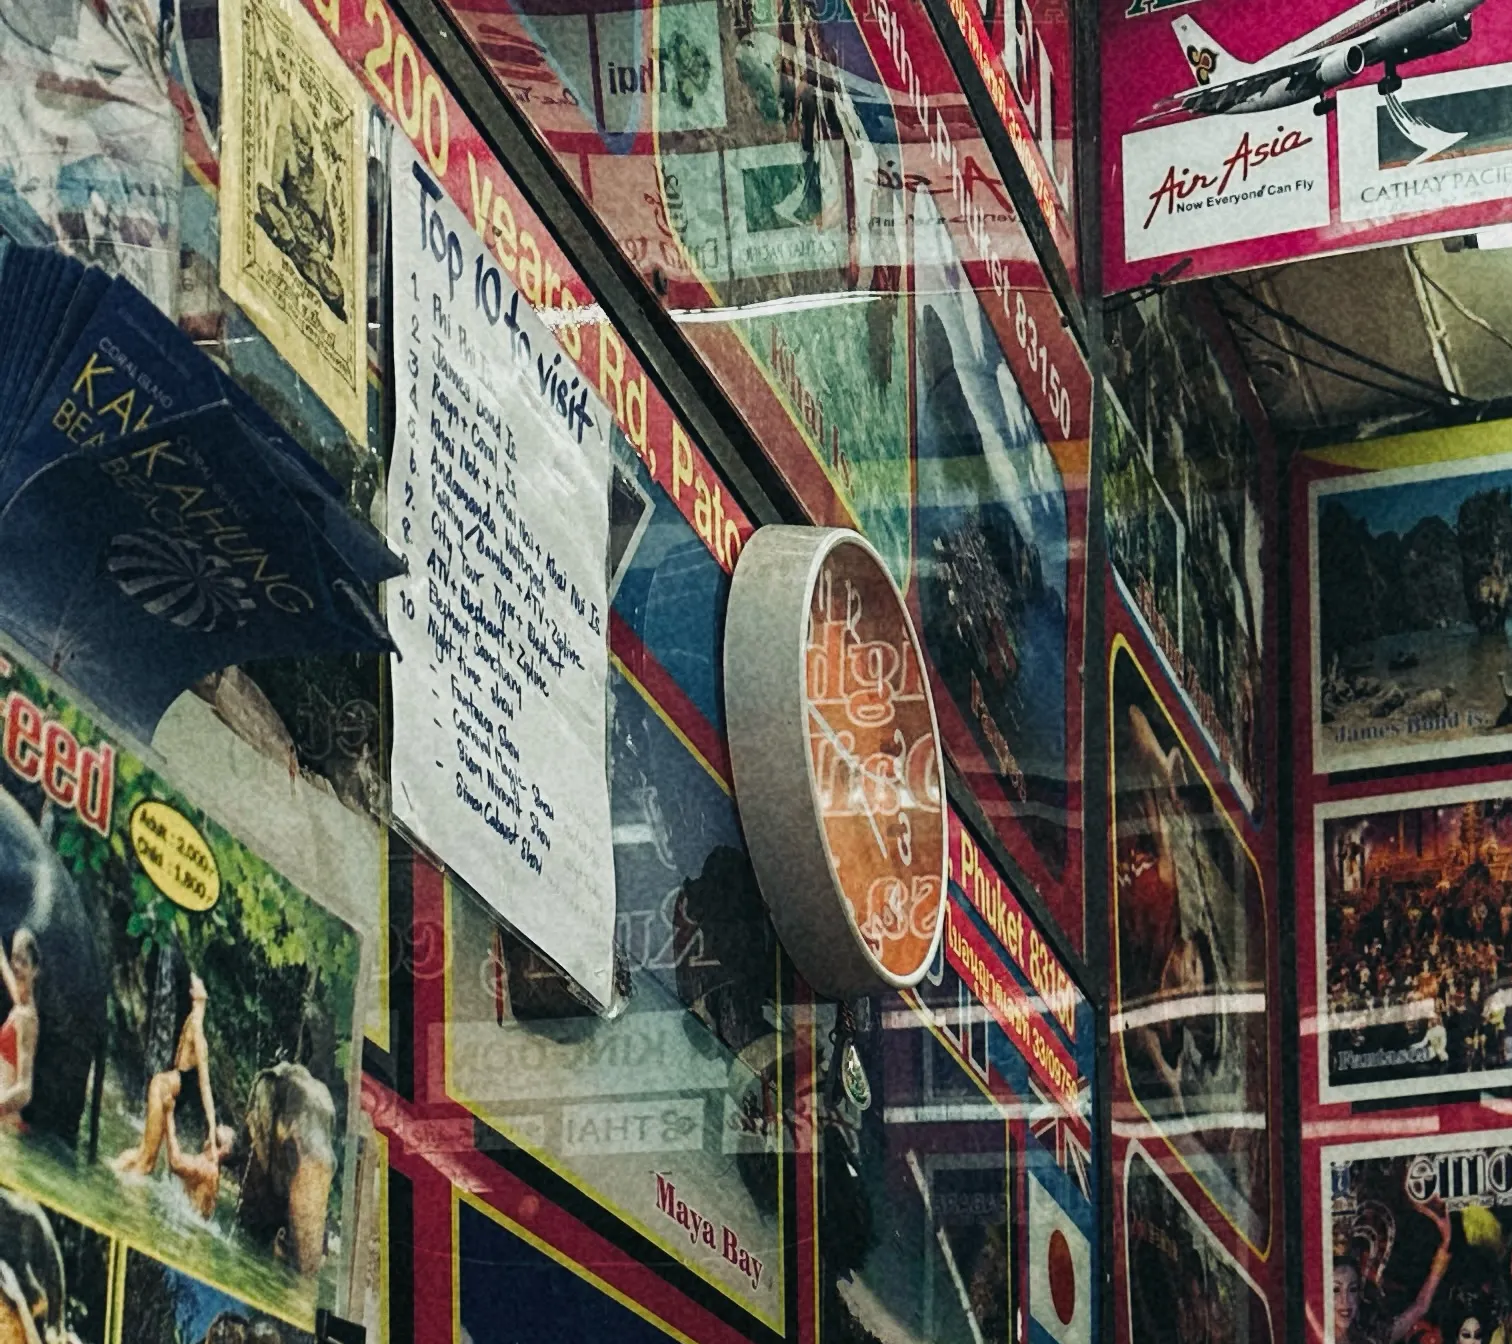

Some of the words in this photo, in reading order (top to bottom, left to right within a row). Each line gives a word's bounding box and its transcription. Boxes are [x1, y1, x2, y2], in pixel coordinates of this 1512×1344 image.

[1144, 164, 1219, 229] Air
[1222, 120, 1312, 182] Asia
[1176, 198, 1204, 214] Now
[1205, 185, 1265, 210] Everyone
[1267, 181, 1293, 197] Can
[1294, 178, 1315, 195] Fly
[1360, 175, 1447, 206] CATHAY
[364, 0, 449, 178] 200
[599, 321, 659, 474] Rd,
[411, 314, 421, 344] 2
[412, 160, 464, 301] Top
[474, 253, 500, 327] 10
[536, 352, 594, 444] visit
[408, 348, 419, 379] 3
[1015, 290, 1071, 441] 83150
[400, 588, 415, 621] 10
[427, 547, 450, 588] ATV
[960, 827, 1024, 969] Phuket
[1029, 929, 1076, 1037] 83150
[654, 1173, 716, 1250] Maya
[722, 1224, 764, 1291] Bay
